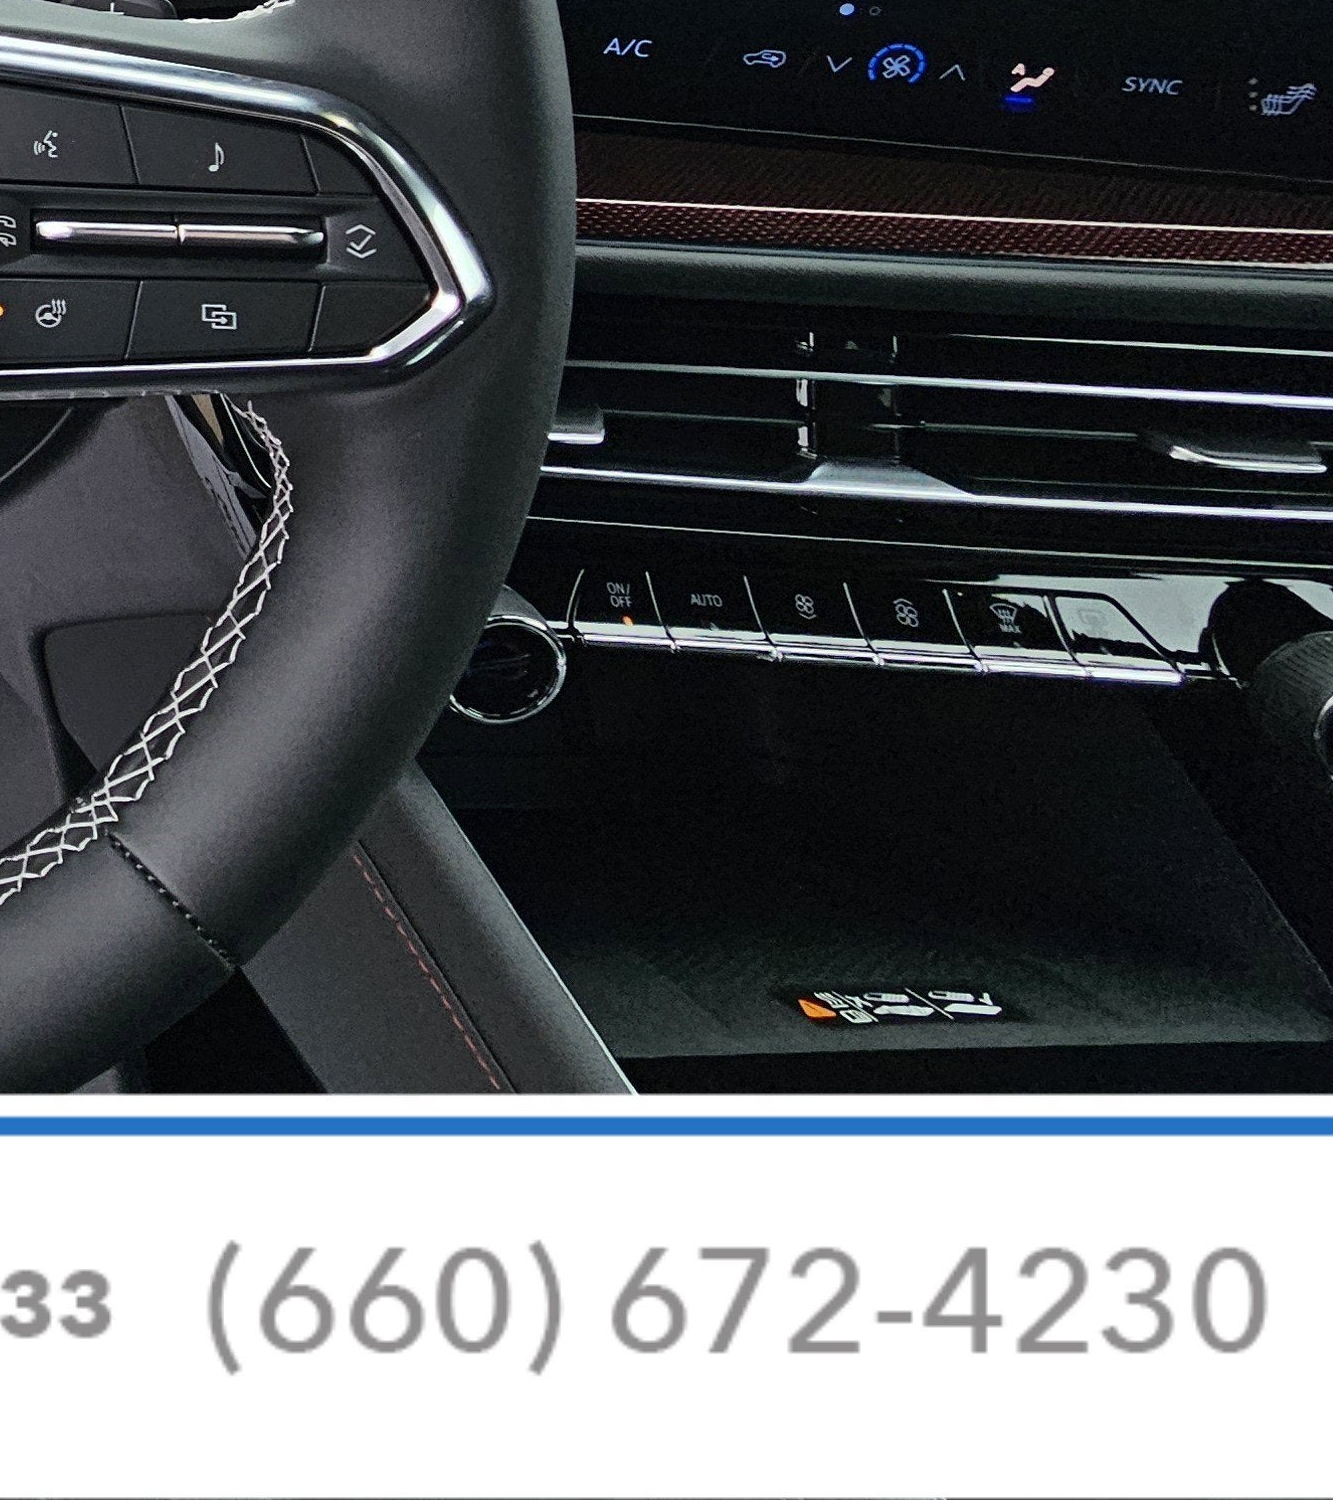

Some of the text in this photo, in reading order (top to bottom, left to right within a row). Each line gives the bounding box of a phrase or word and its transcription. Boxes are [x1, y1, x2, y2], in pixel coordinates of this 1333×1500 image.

[604, 38, 652, 57] A/C
[1122, 77, 1182, 95] SYNC
[607, 582, 630, 595] ON/
[610, 596, 632, 607] OFF
[691, 594, 722, 607] AUTO
